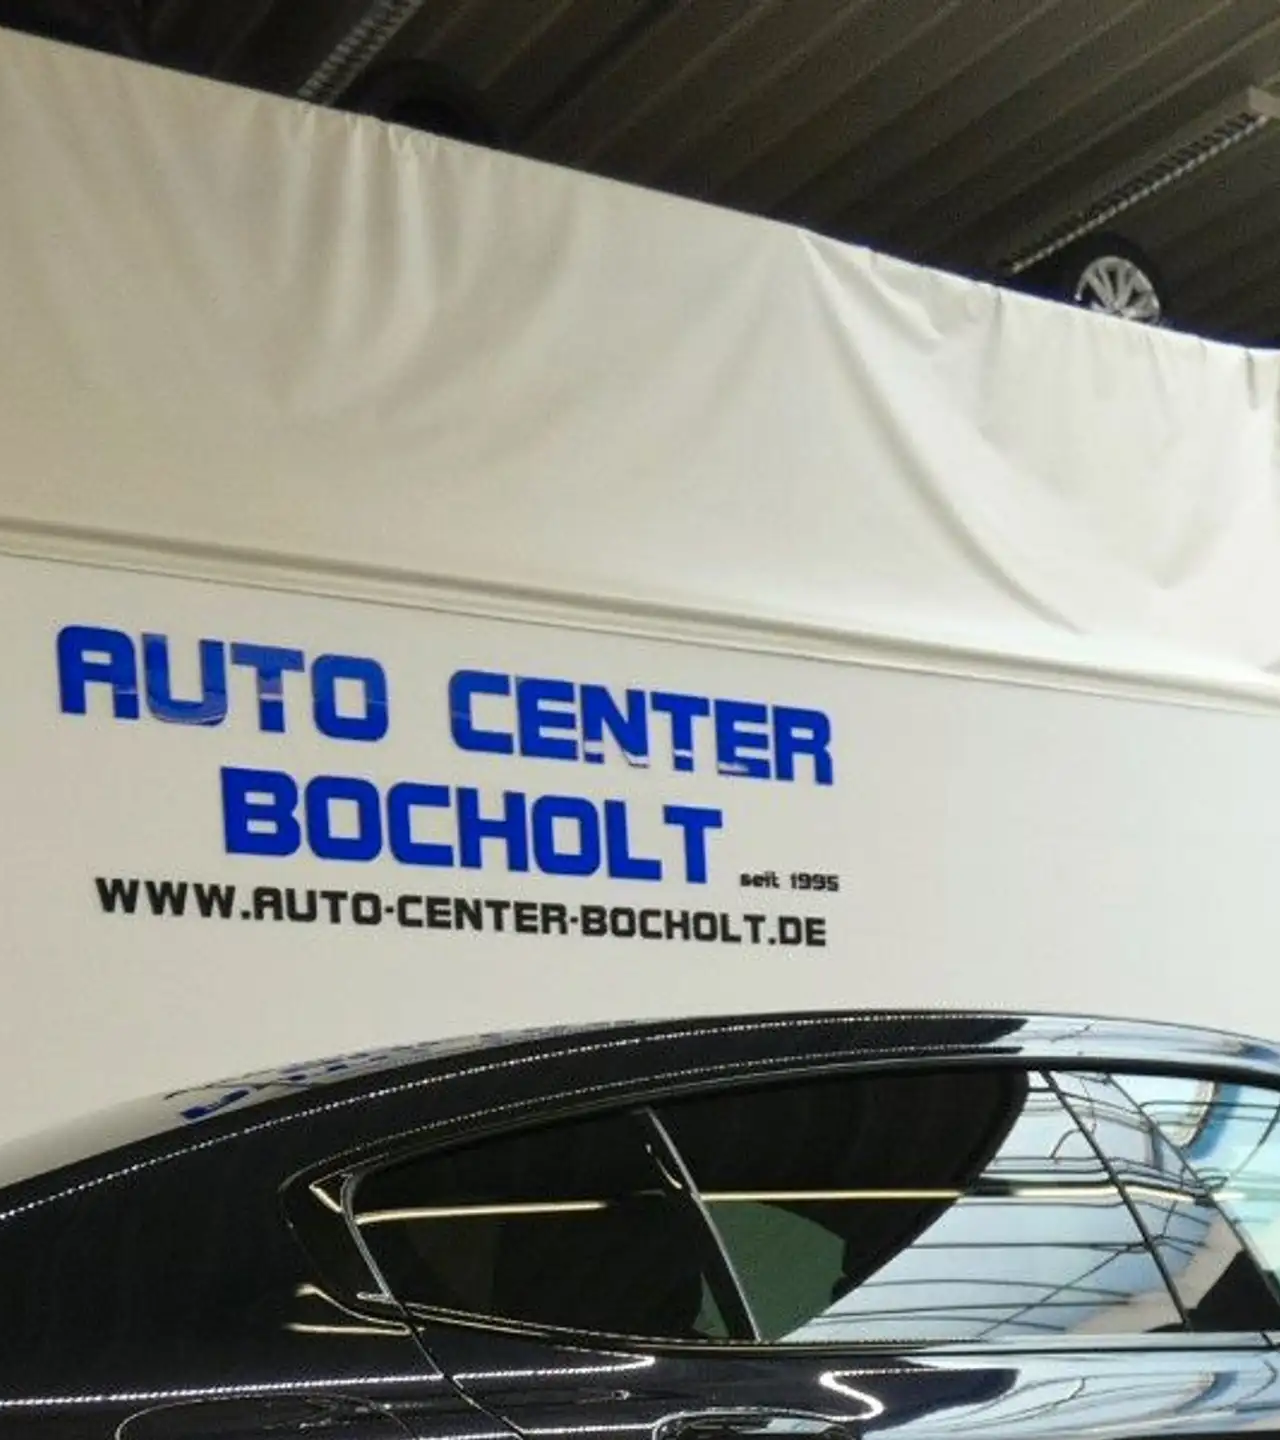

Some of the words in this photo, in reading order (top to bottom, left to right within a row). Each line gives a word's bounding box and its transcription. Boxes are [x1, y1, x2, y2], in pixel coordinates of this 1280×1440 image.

[56, 625, 390, 743] AUTO
[448, 670, 834, 786] CENTER
[220, 766, 723, 885] BOCHOLT
[95, 877, 826, 947] WWW.AUTO-CENTER-BOCHOLT.DE
[740, 871, 780, 889] seit
[790, 873, 839, 892] 1995
